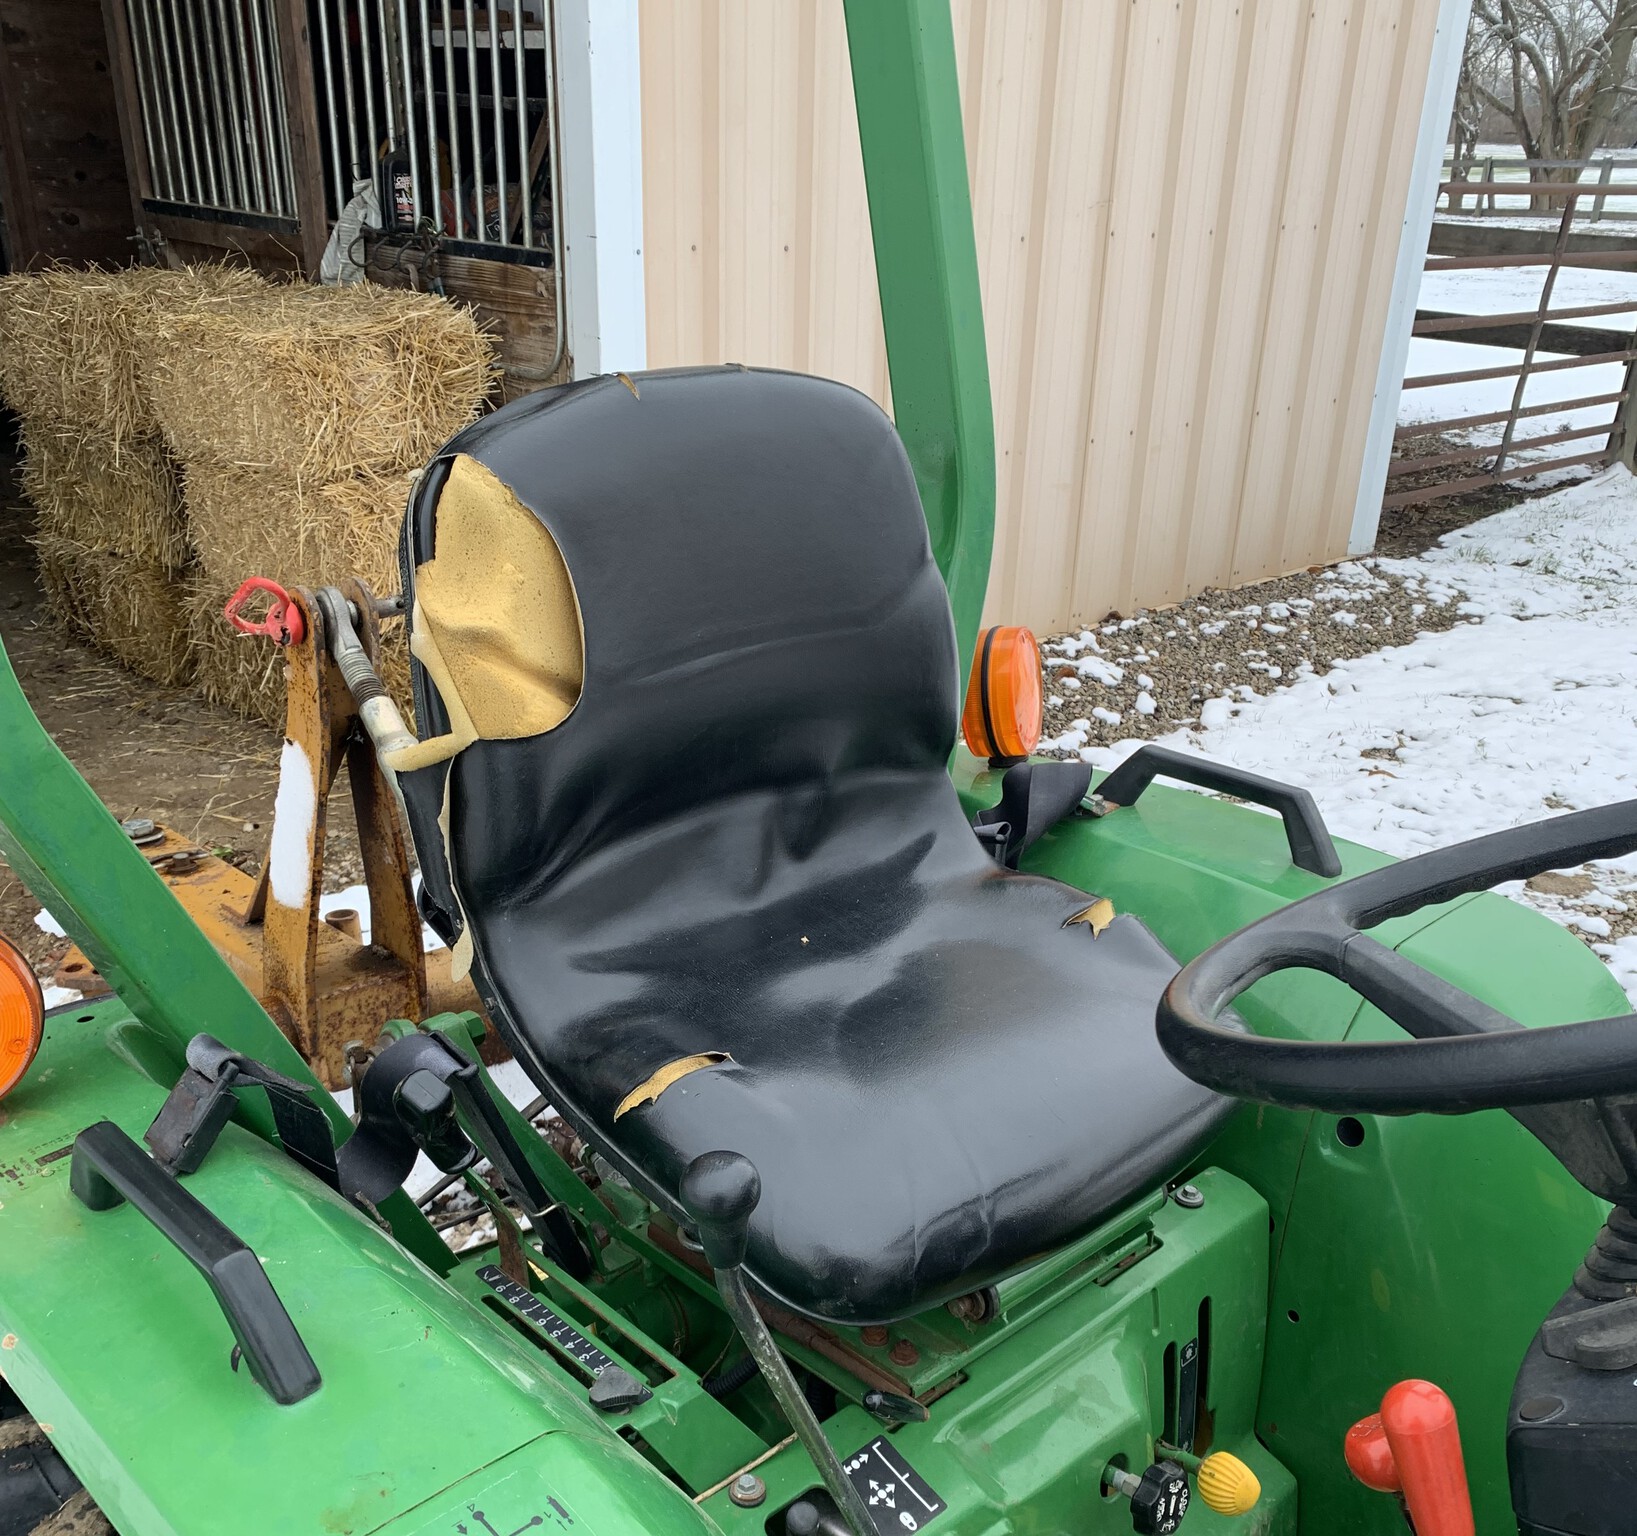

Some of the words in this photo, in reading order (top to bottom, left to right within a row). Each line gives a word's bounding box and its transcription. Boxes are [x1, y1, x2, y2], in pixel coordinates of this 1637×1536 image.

[495, 1285, 506, 1293] 9
[508, 1296, 520, 1304] 8
[536, 1318, 547, 1326] 6
[549, 1330, 561, 1338] 5
[578, 1353, 590, 1361] 3
[593, 1365, 604, 1375] 2
